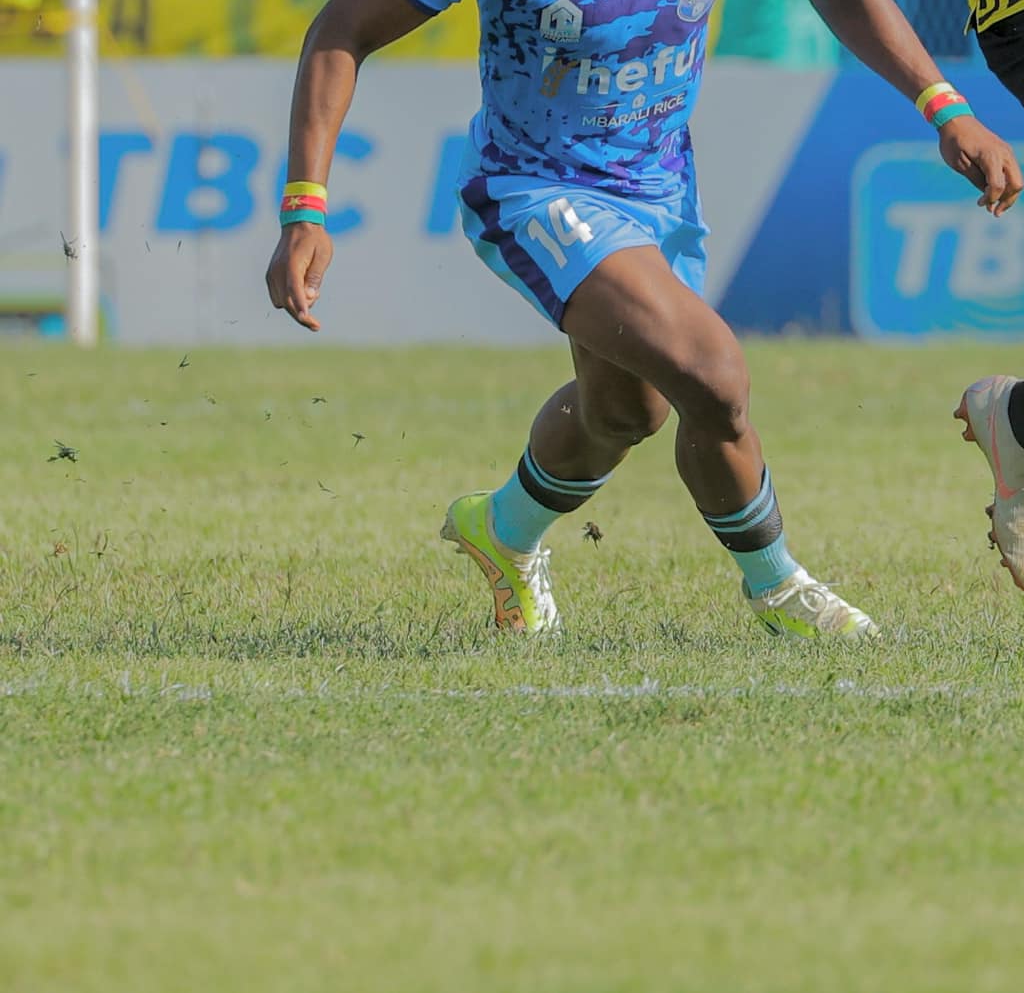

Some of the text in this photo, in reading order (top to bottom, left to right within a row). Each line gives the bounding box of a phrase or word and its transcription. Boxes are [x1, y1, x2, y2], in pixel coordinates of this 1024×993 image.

[581, 92, 686, 129] MBARALI RICE
[64, 131, 374, 235] TBC
[527, 197, 594, 269] 14
